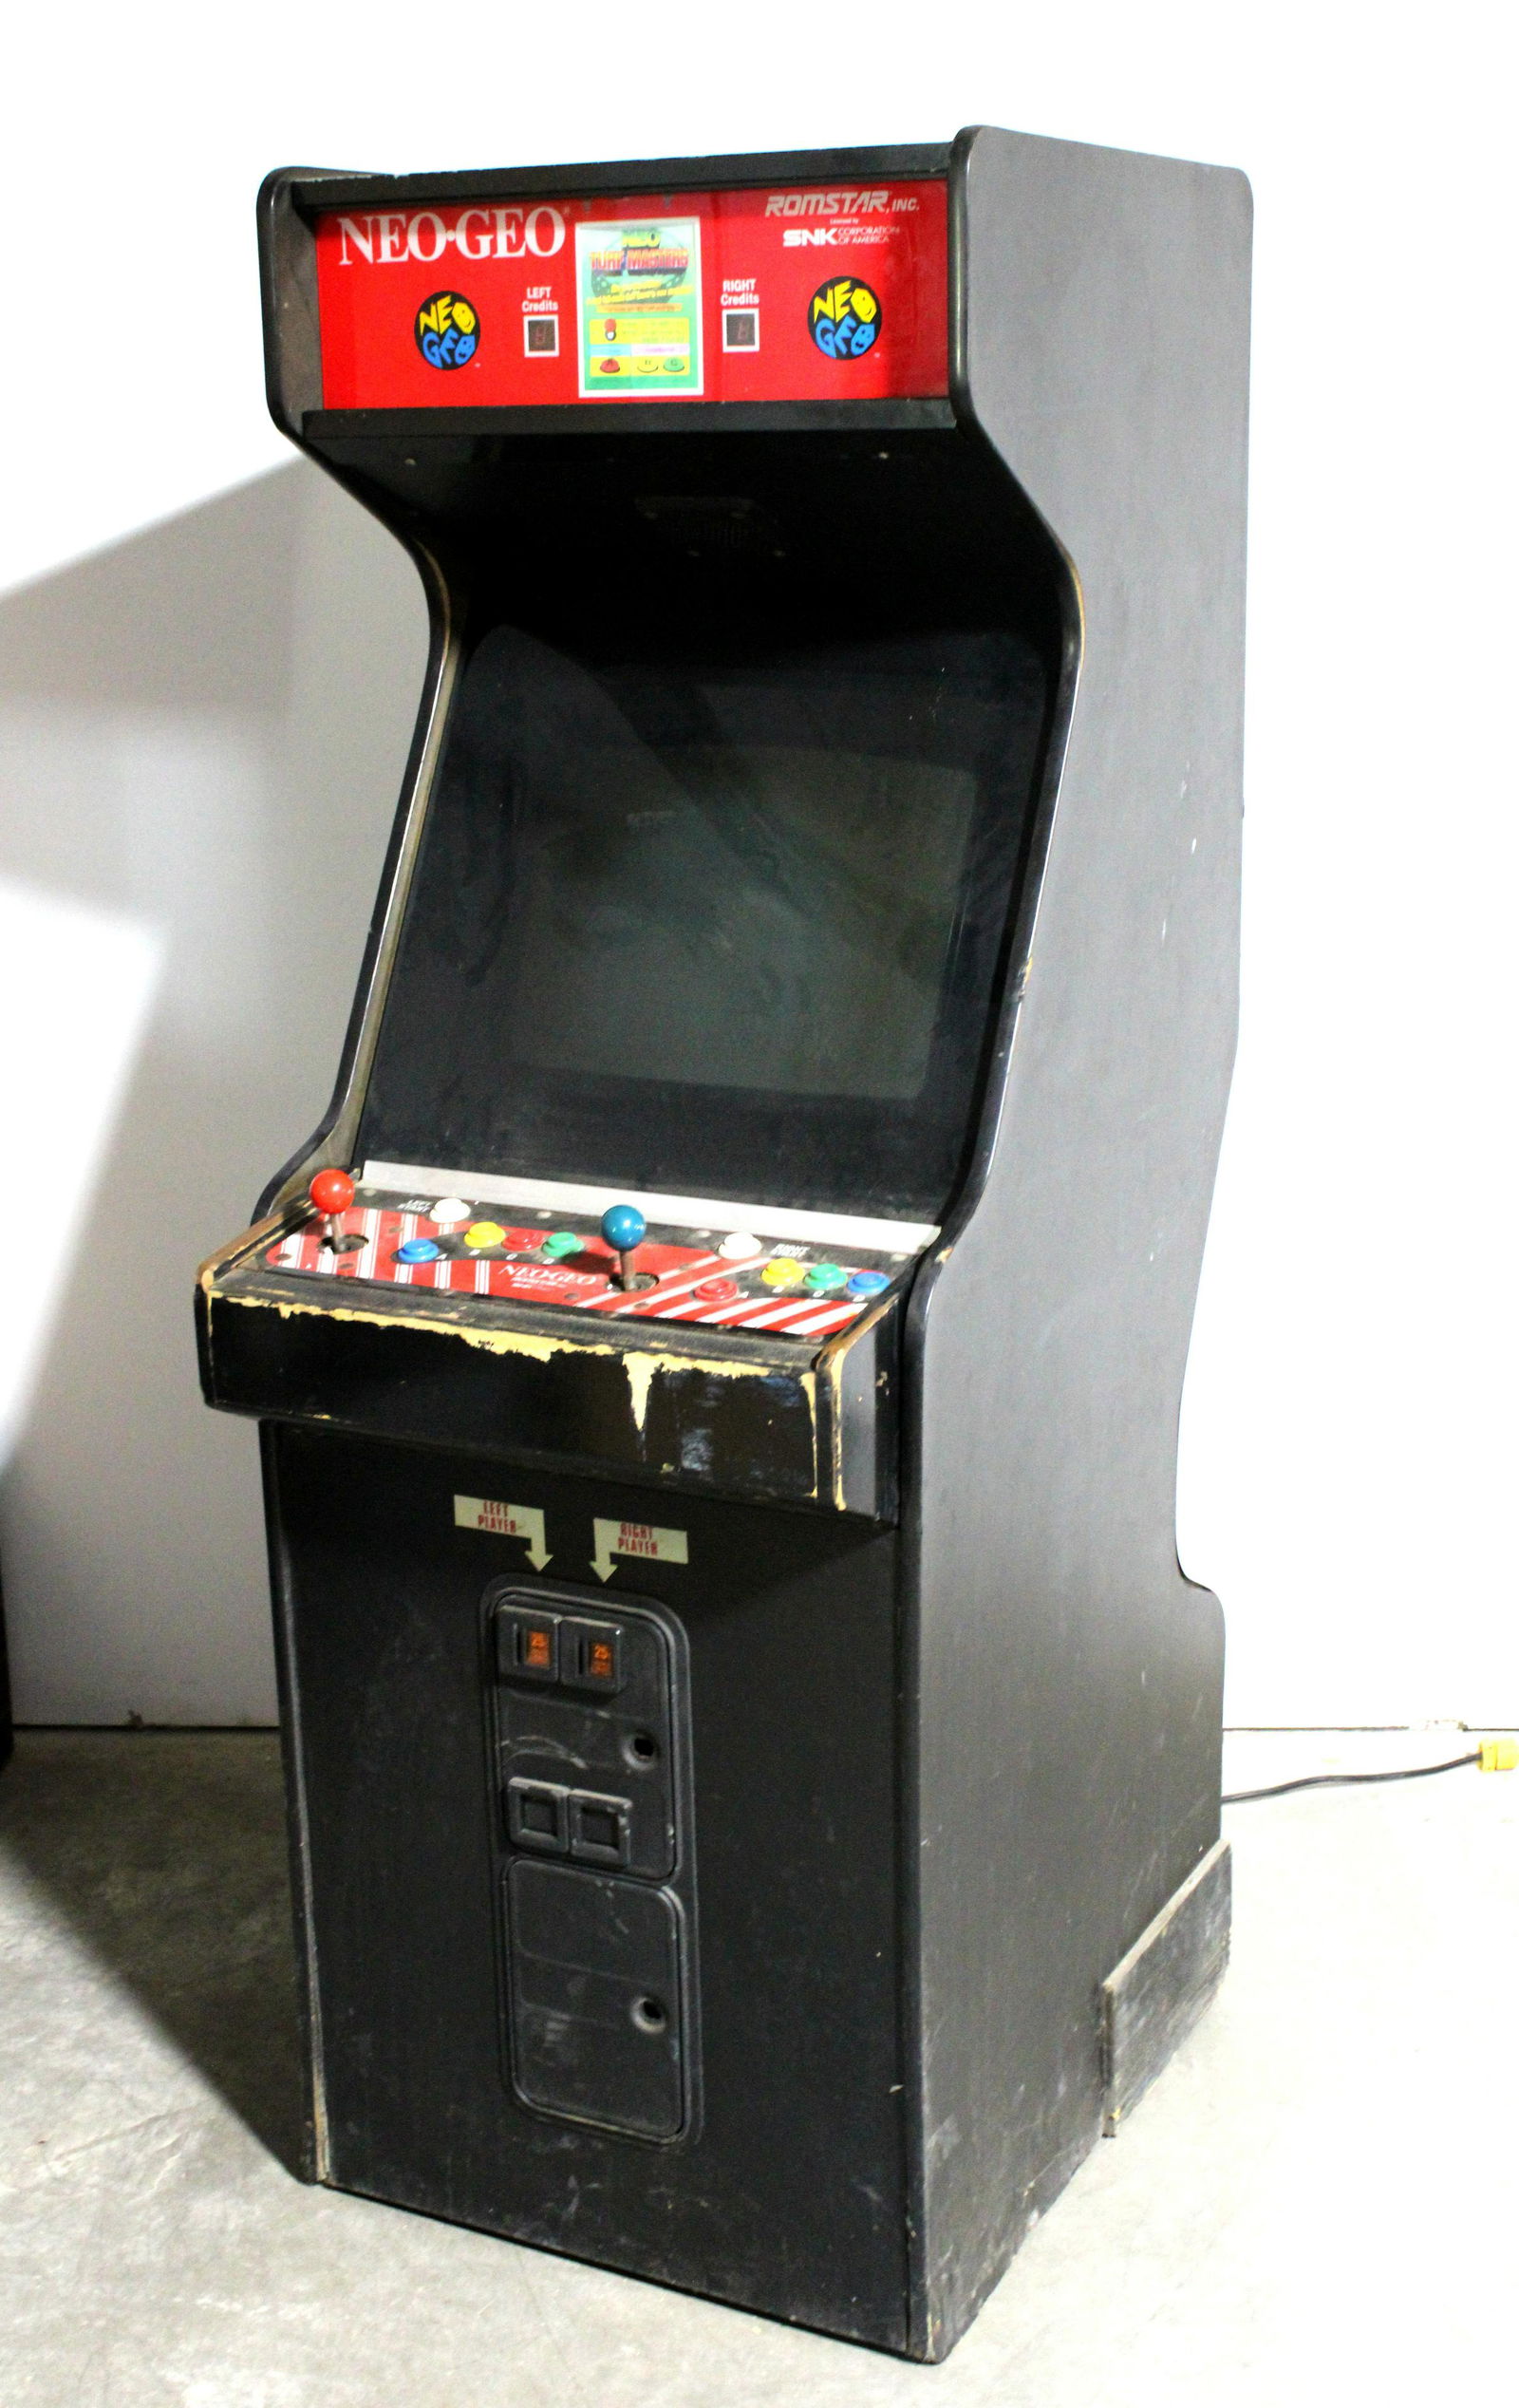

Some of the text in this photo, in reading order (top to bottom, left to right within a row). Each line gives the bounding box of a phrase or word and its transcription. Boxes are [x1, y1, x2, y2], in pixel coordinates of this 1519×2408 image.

[892, 198, 920, 212] INC.
[783, 228, 837, 247] SNK
[527, 287, 552, 299] LEFT
[722, 279, 757, 292] RIGHT
[521, 300, 559, 312] Credits
[721, 292, 760, 306] Credits
[814, 281, 877, 323] NEO
[419, 295, 476, 335] NEO
[483, 1500, 509, 1516] LEFT
[478, 1514, 516, 1534] PLAYER
[620, 1522, 653, 1539] RIGHT
[618, 1537, 658, 1555] PLAYER
